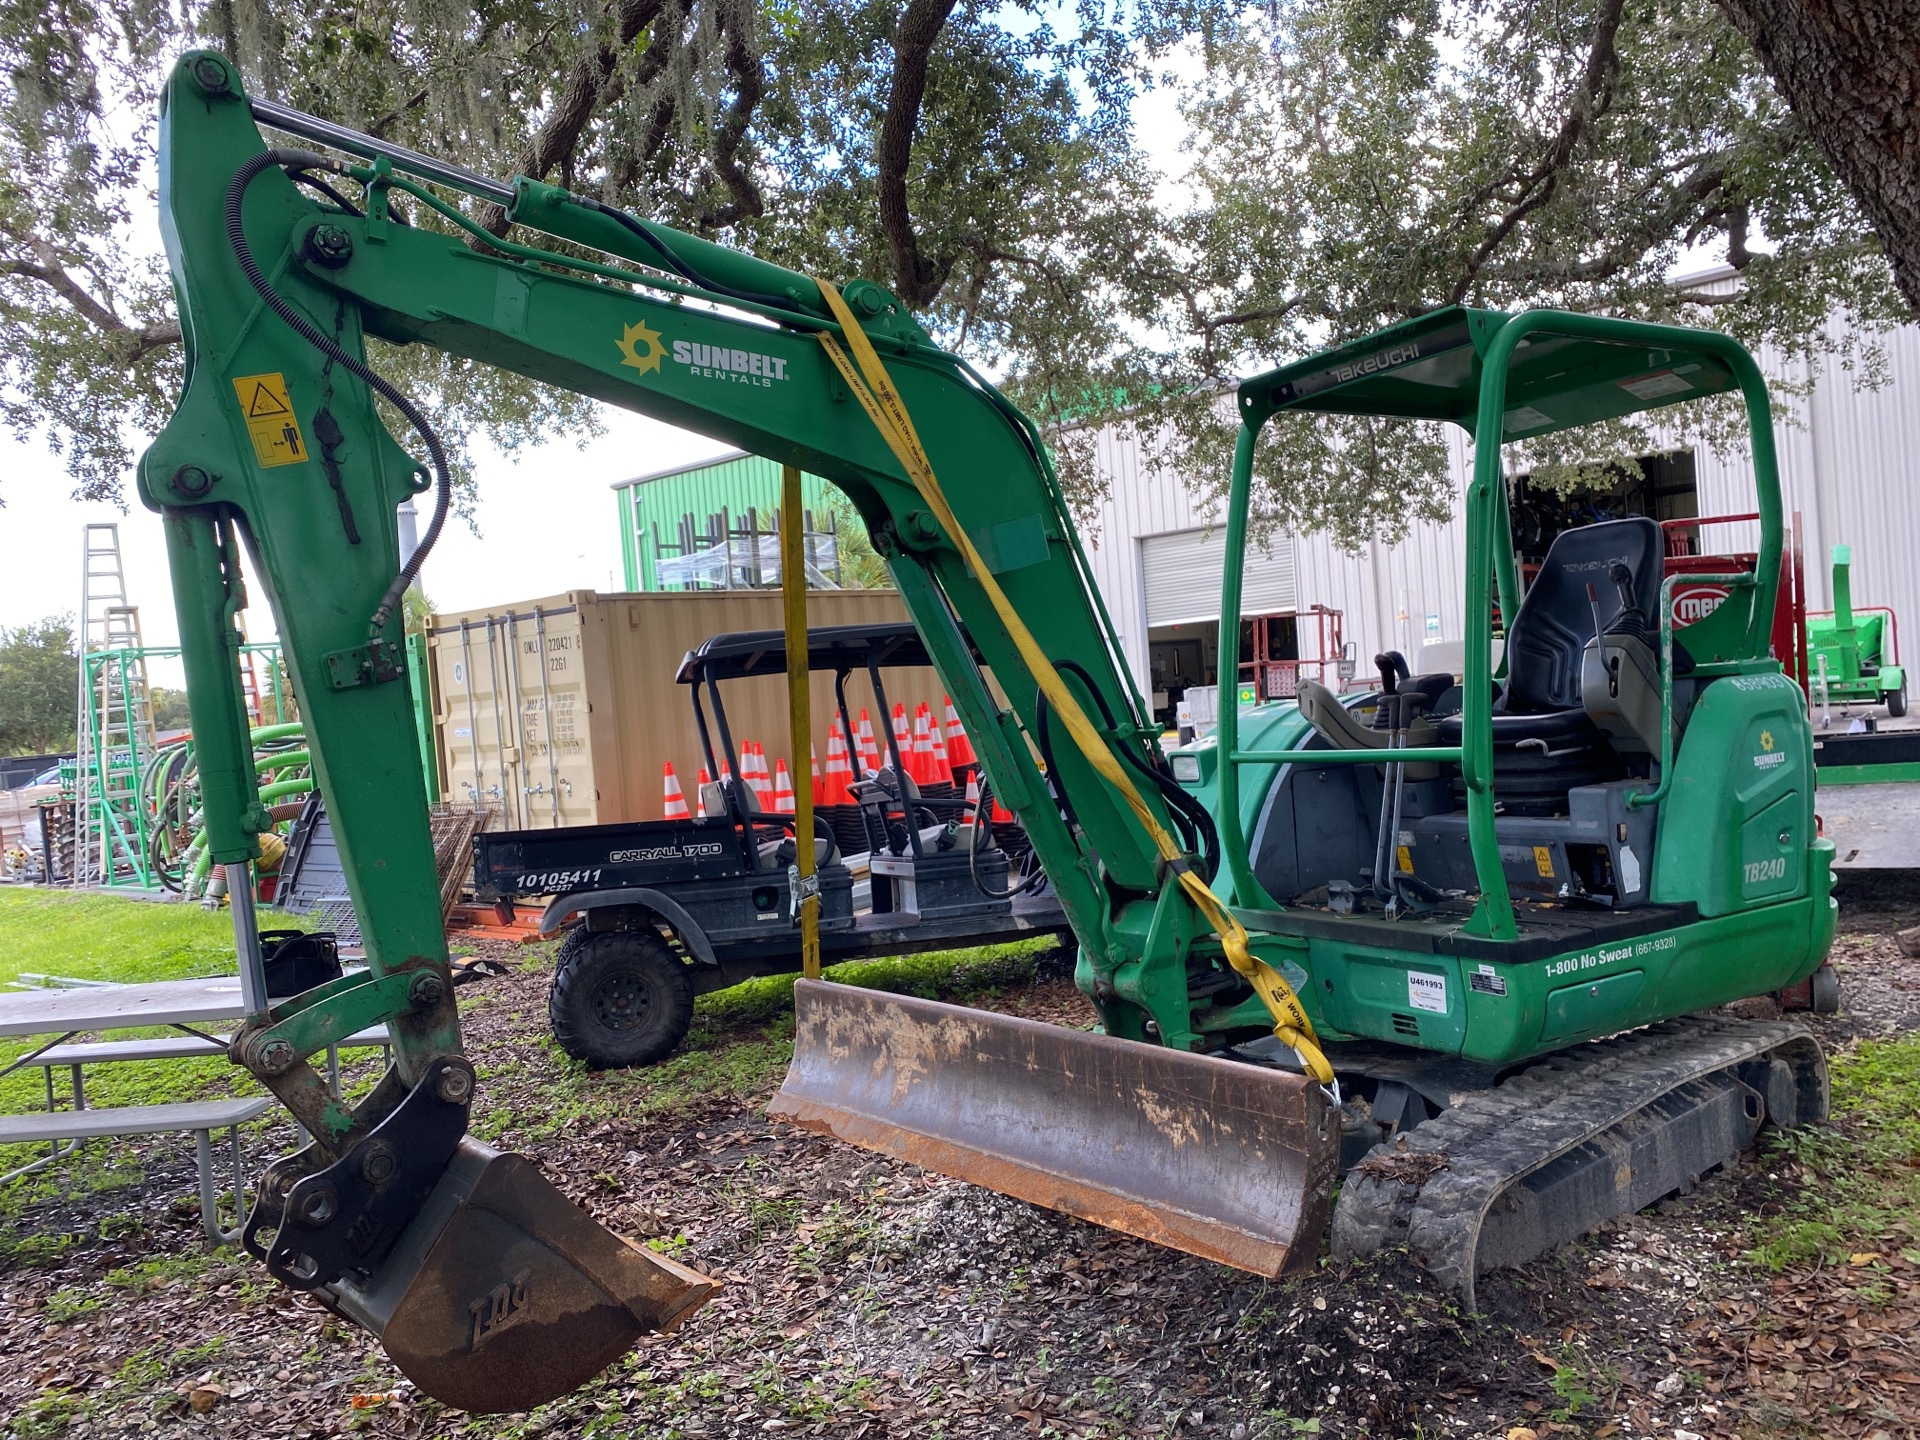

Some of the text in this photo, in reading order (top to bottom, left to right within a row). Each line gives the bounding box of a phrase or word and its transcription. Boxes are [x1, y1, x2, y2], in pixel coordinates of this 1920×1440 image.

[673, 340, 787, 380] SUNBELT
[690, 366, 771, 387] RENTALS
[548, 636, 572, 651] 220421
[550, 656, 567, 671] 22G1
[1753, 752, 1785, 767] SUNBELT
[610, 843, 722, 863] CARRYALL 1700
[516, 869, 601, 888] 10105411
[1744, 857, 1786, 884] TB240
[543, 883, 573, 893] PC227
[1545, 935, 1677, 977] 1-800 No Sweat (667-9328)
[1410, 977, 1443, 990] U461993
[1287, 1002, 1306, 1028] WORK
